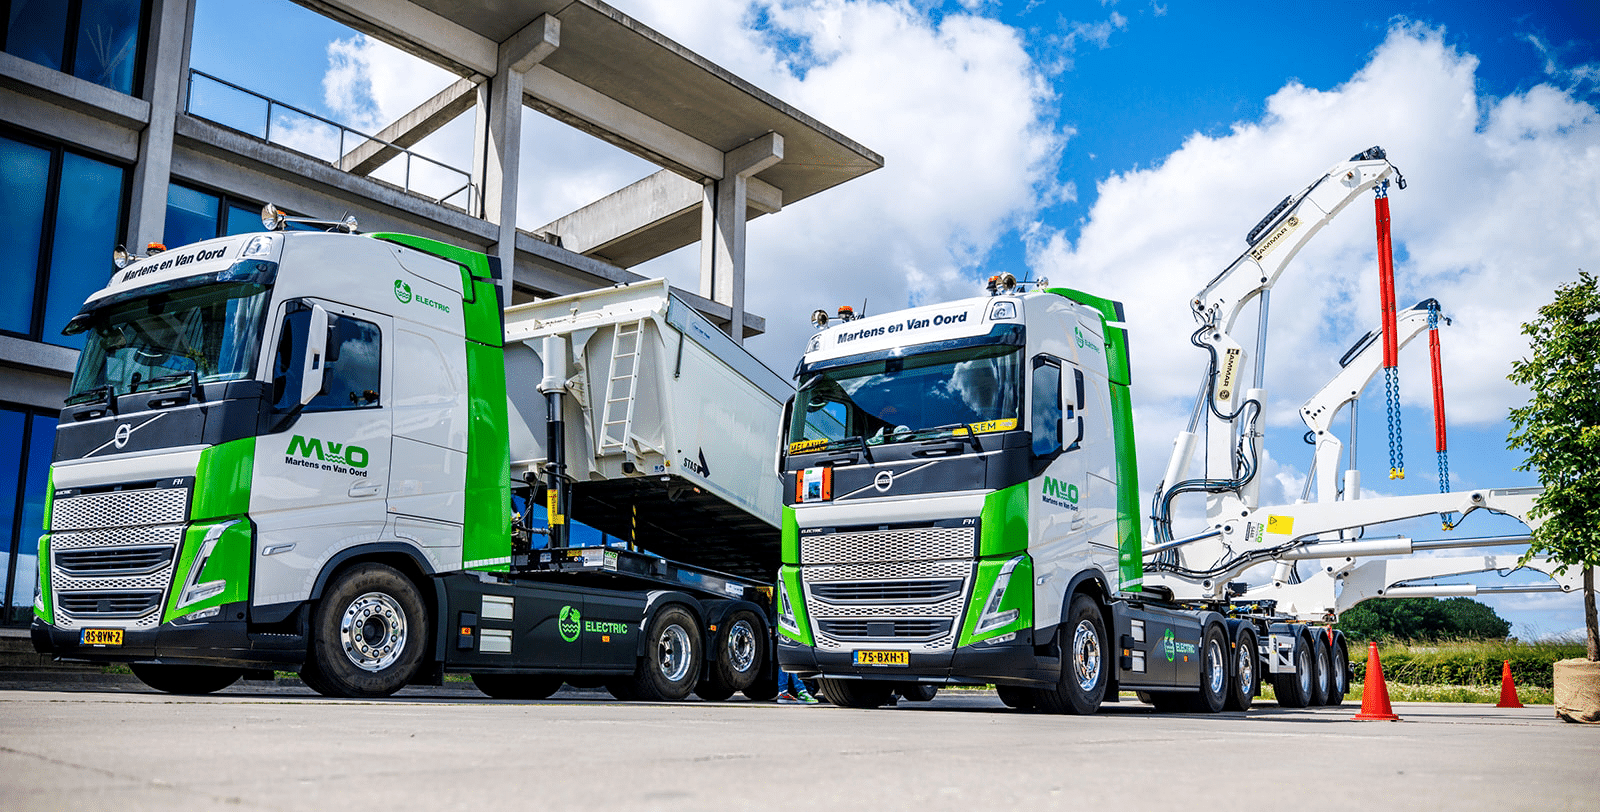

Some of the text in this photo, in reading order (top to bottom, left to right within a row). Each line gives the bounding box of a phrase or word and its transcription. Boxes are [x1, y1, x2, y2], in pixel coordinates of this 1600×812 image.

[1251, 227, 1288, 261] HAMMAR
[121, 246, 228, 283] Martens en Van Oord
[415, 294, 450, 313] ELECTRIC
[837, 311, 968, 344] Martens en Van Oord
[1223, 348, 1240, 387] HAMMAR
[285, 456, 368, 478] Martens en Van Oord
[683, 457, 698, 473] STAS
[172, 478, 184, 486] FH
[585, 620, 628, 635] ELECTRIC
[862, 652, 904, 663] 75-BXH-1
